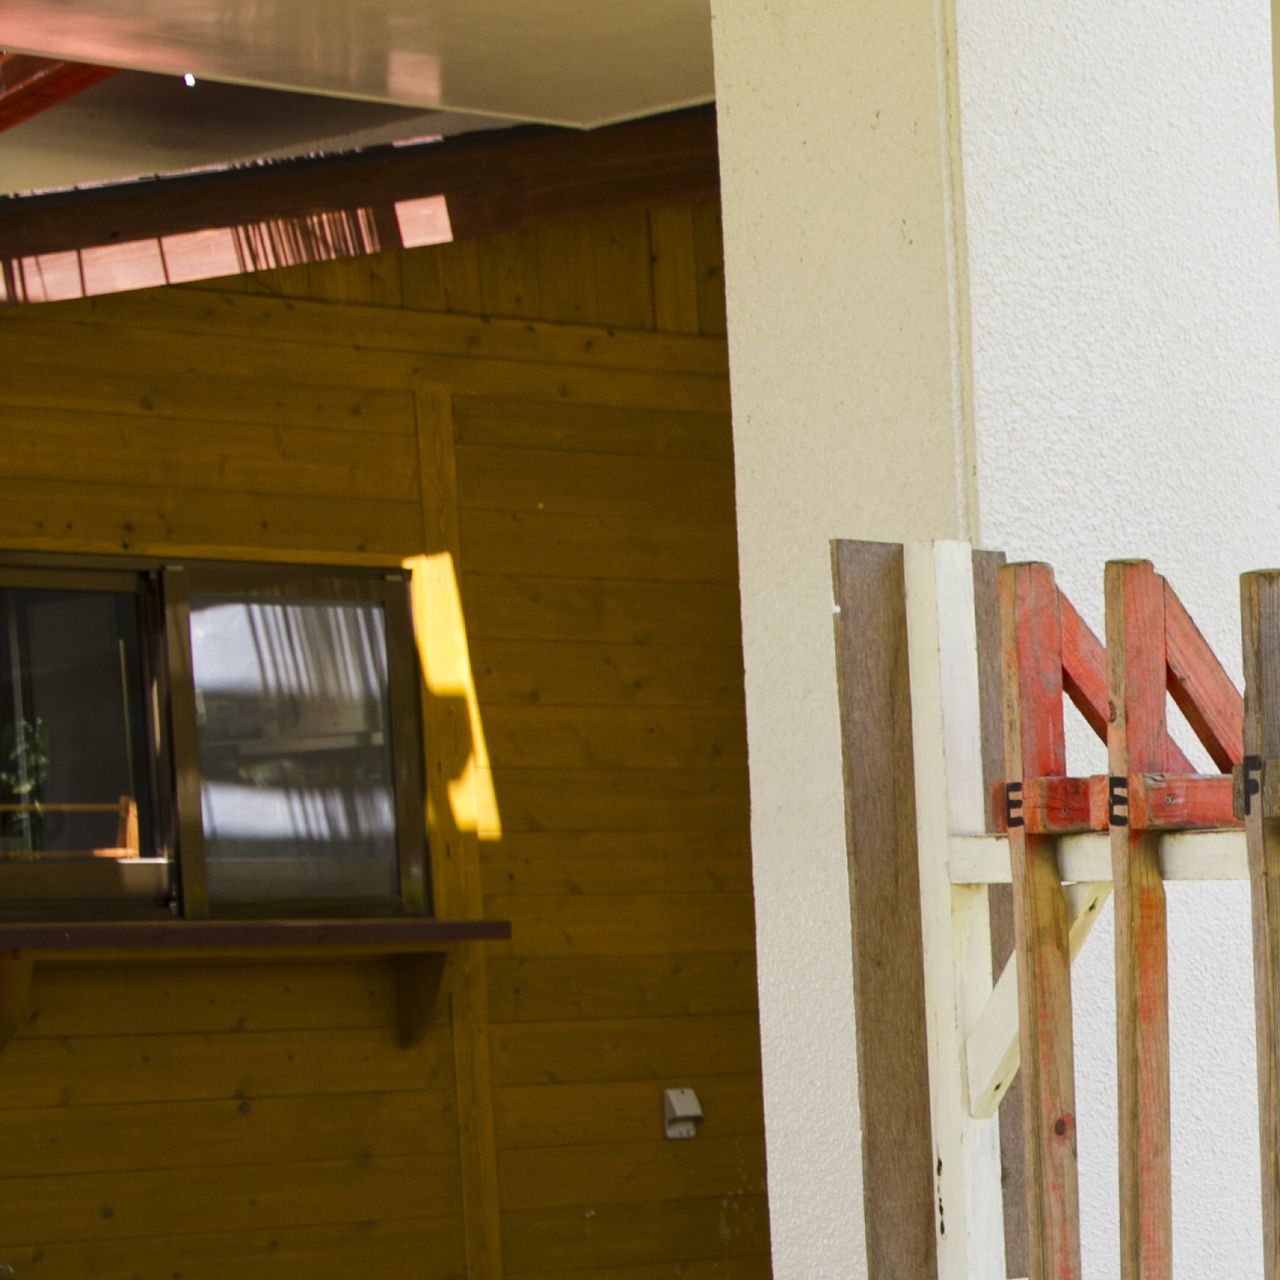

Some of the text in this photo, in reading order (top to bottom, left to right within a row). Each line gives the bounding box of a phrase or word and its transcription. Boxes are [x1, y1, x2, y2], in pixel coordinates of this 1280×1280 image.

[1006, 782, 1023, 828] E
[1109, 776, 1129, 827] E
[1243, 755, 1262, 815] F
